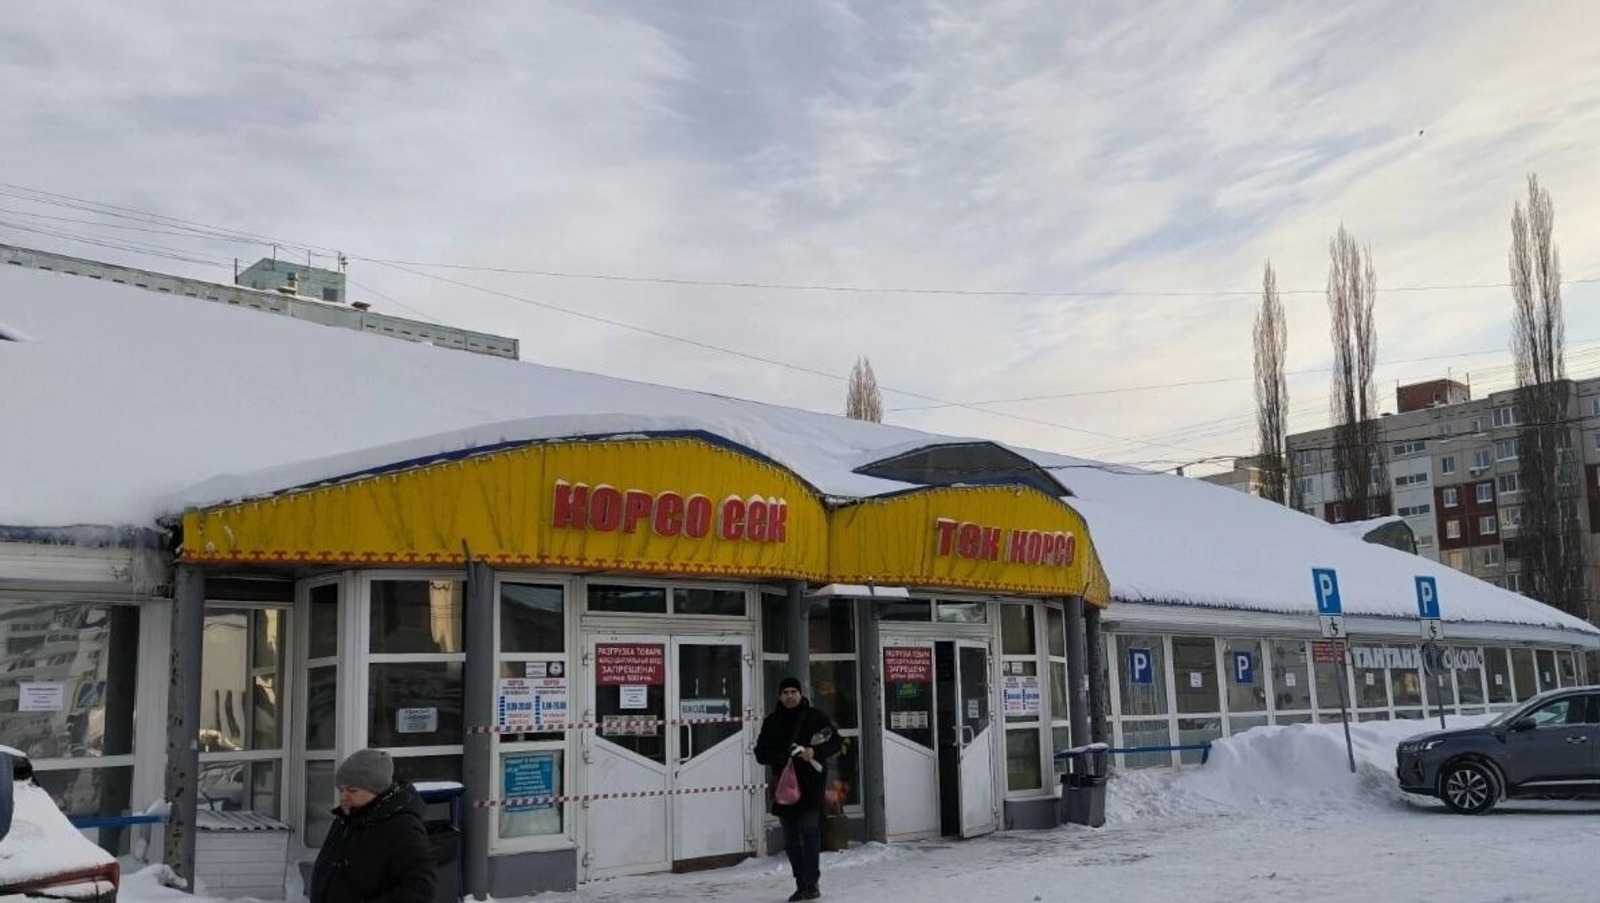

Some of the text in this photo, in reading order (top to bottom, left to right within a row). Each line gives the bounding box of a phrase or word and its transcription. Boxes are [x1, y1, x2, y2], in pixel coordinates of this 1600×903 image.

[552, 480, 712, 538] КОРСО
[936, 517, 1076, 567] ТСК КОРСО
[598, 647, 662, 656] РАЗГРУЗКА ТОВАРА
[601, 665, 656, 675] ЗАПРЕЩЕНА!
[682, 704, 706, 714] ВХОД
